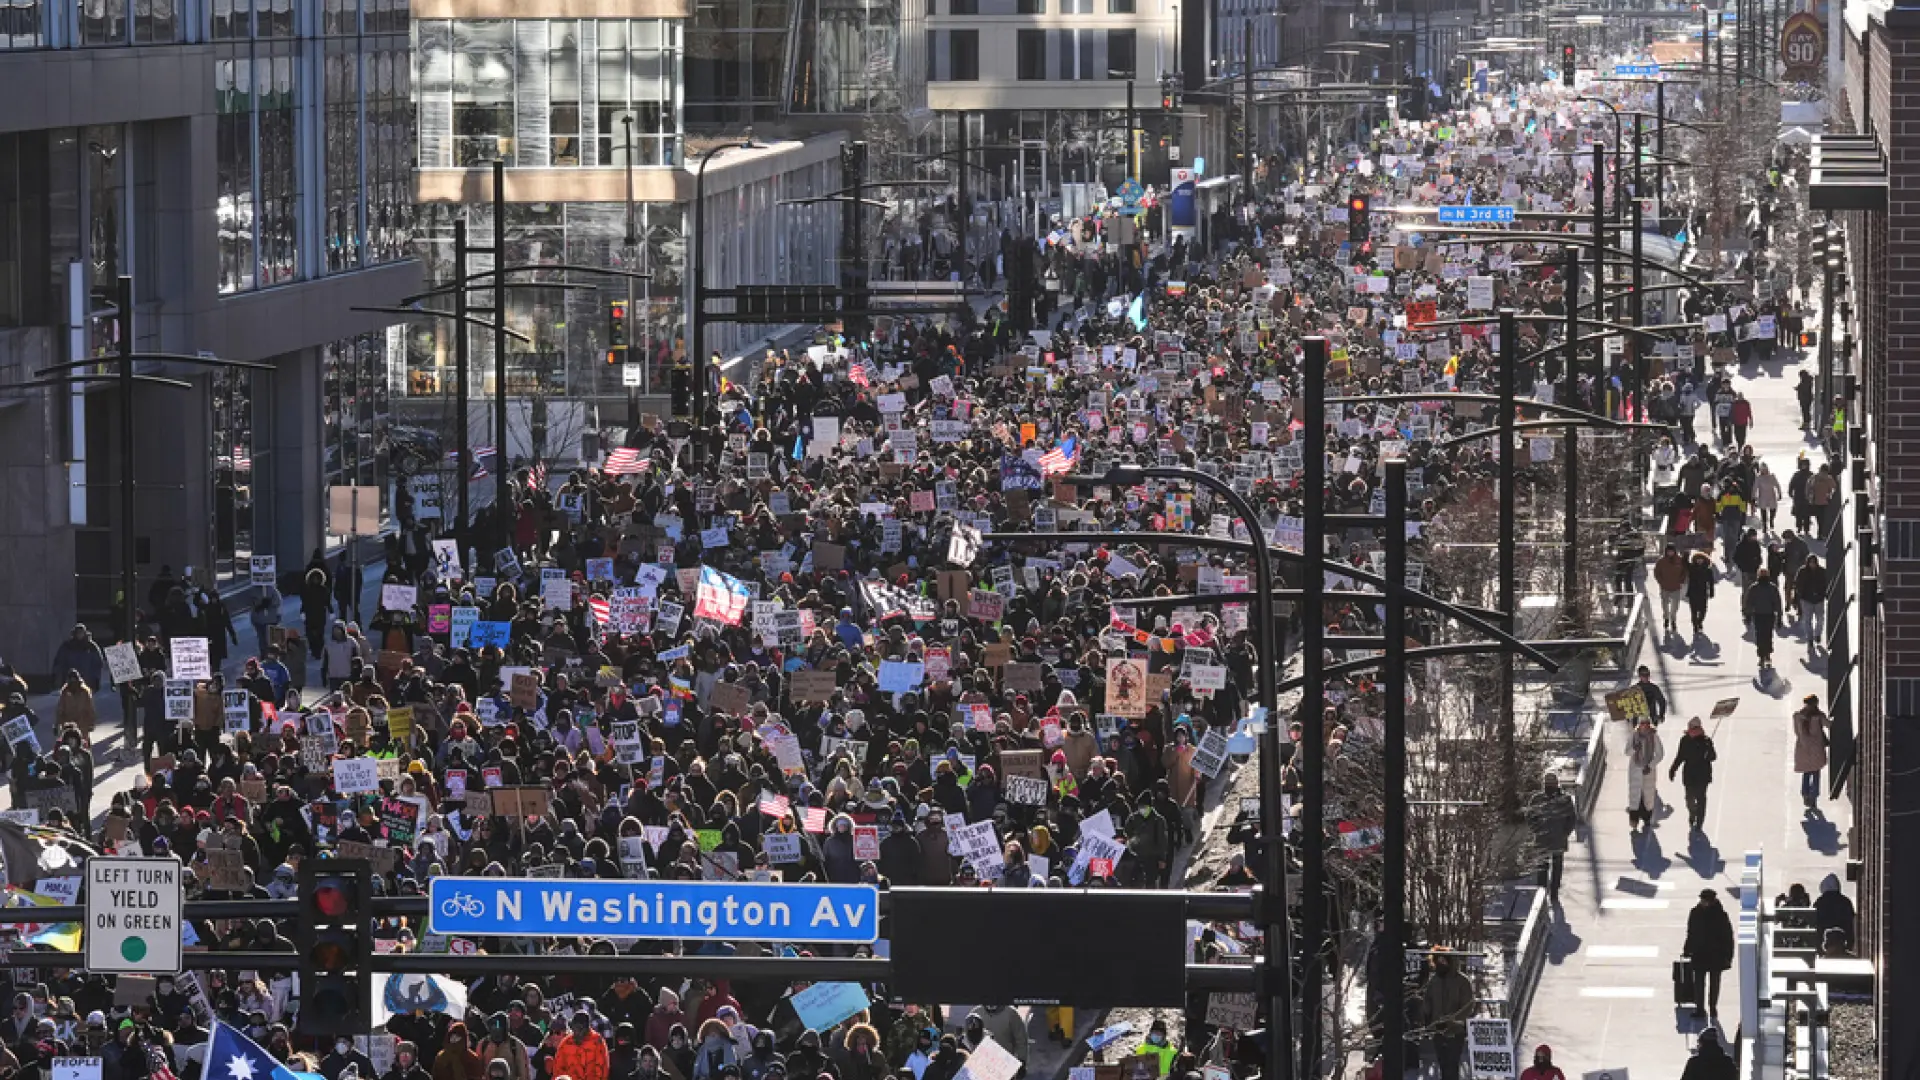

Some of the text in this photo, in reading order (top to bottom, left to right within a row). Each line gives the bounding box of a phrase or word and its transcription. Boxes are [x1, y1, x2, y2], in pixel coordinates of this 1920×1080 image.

[1790, 43, 1814, 61] 90
[1456, 210, 1511, 219] N 3rd St
[95, 869, 173, 885] LEFT TURN
[110, 890, 159, 909] YIELD
[496, 889, 866, 935] N Washington Av
[97, 914, 172, 930] ON GREEN
[53, 1058, 100, 1068] PEOPLE
